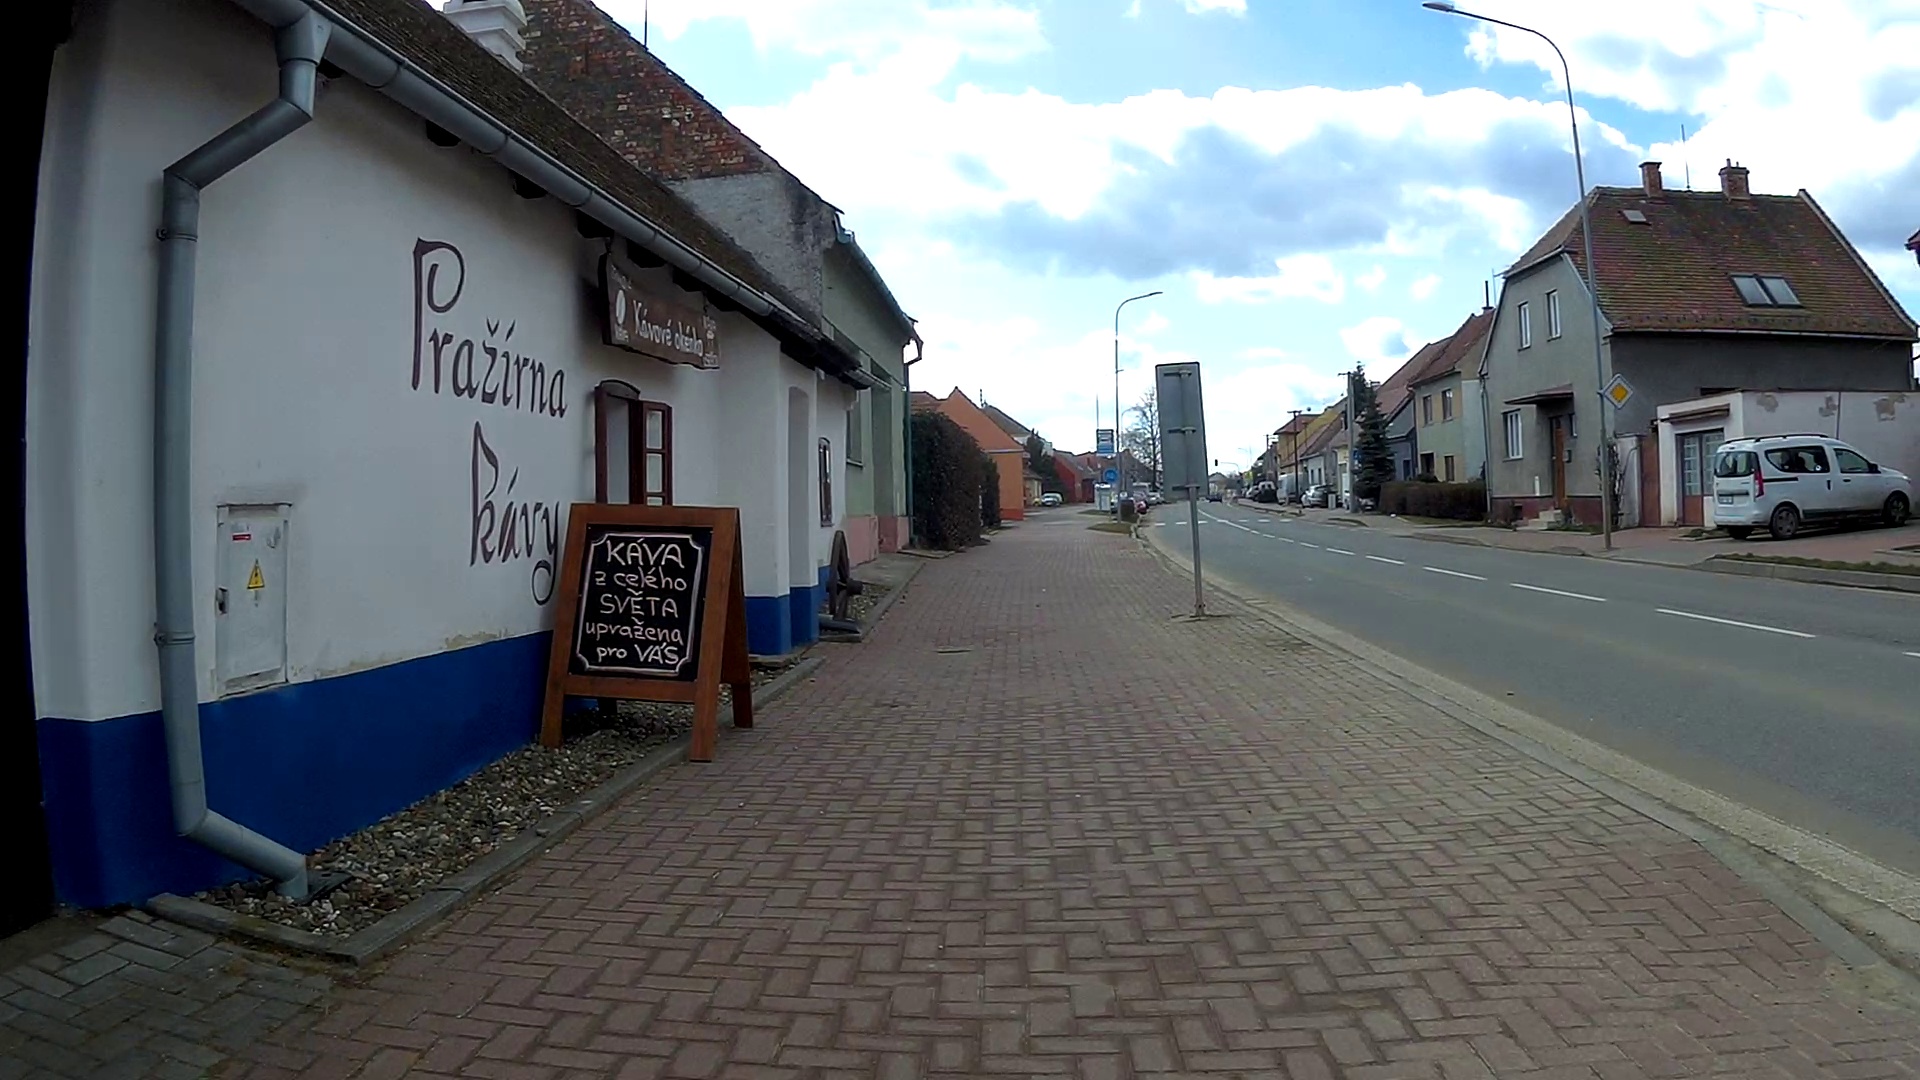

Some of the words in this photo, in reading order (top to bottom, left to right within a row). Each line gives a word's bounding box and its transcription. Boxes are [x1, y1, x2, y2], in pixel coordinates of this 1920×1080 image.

[411, 237, 567, 418] Pražírna
[606, 538, 684, 568] KÁVA
[614, 566, 687, 591] celého
[600, 588, 678, 618] SVĚTA
[586, 617, 684, 645] upražena
[596, 646, 627, 662] pro
[634, 643, 679, 664] VÁS
